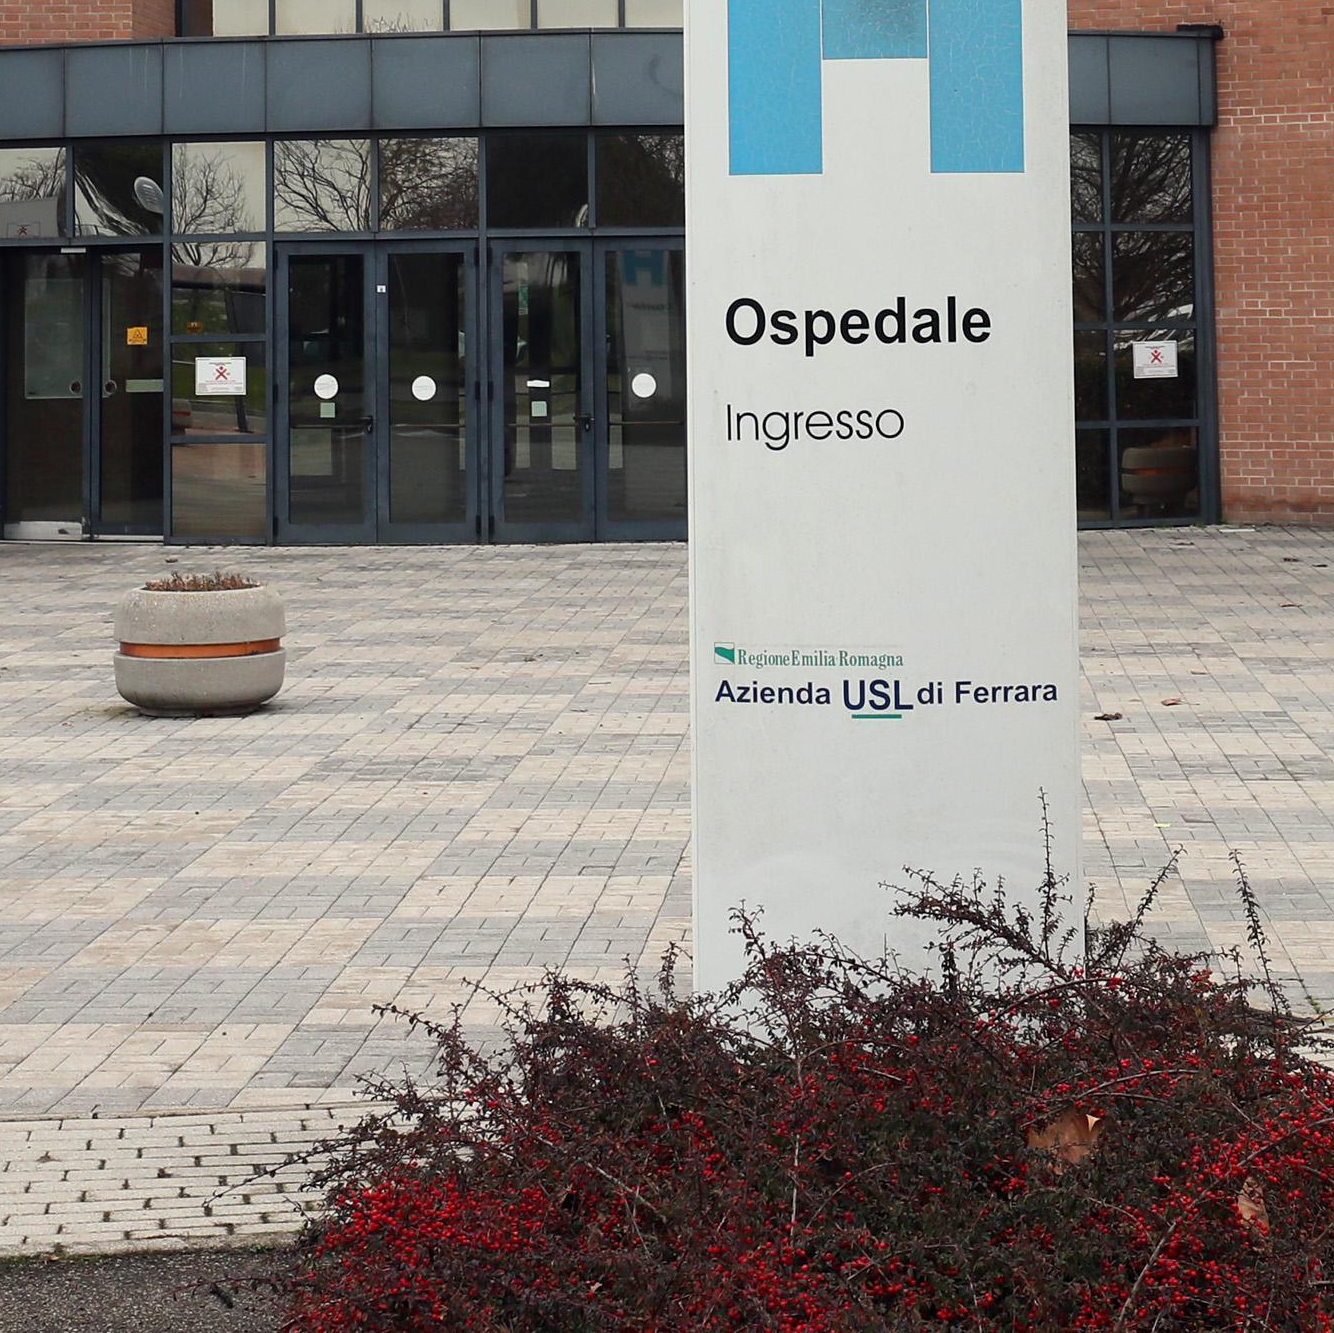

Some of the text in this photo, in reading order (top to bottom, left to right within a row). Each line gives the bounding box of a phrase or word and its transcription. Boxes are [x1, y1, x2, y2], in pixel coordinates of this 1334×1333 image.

[725, 296, 992, 357] Ospedale
[726, 404, 905, 451] Ingresso
[715, 679, 1058, 711] Azienda USL di Ferrara
